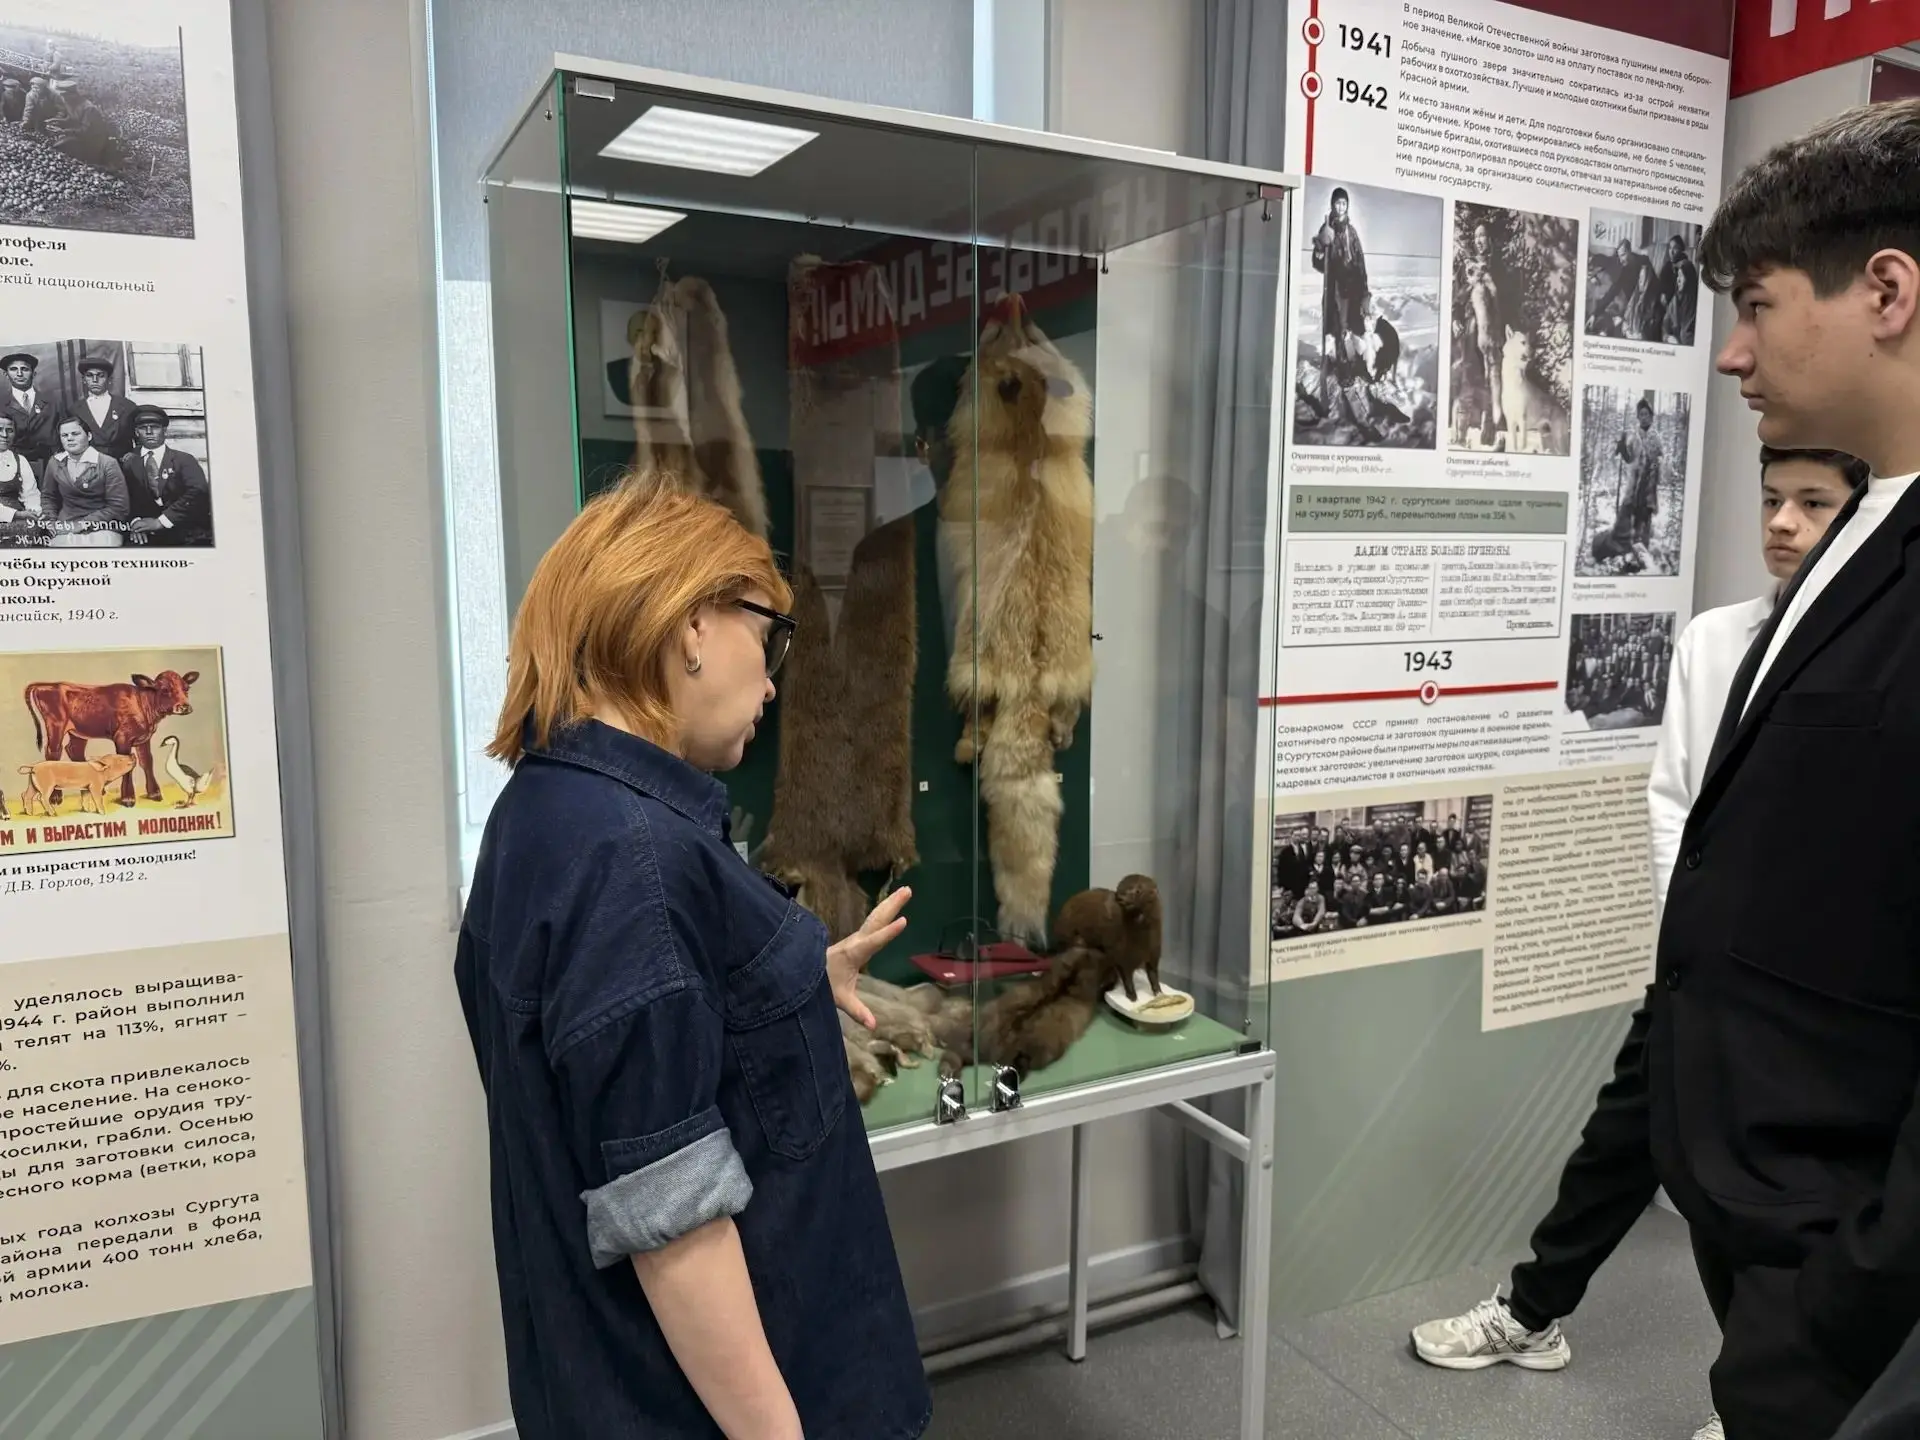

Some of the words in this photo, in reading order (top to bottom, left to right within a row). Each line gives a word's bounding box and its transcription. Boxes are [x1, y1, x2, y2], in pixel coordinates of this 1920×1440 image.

[1338, 24, 1391, 58] 1941
[1402, 19, 1418, 30] ное
[1420, 24, 1464, 42] значение.
[1465, 35, 1500, 50] «Мягкое
[1502, 44, 1534, 58] золото»
[1536, 52, 1554, 63] шло
[1555, 56, 1565, 65] на
[1567, 59, 1595, 74] оплату
[1596, 66, 1632, 80] поставок
[1634, 74, 1644, 83] по
[1645, 77, 1685, 94] ленд-лизу.
[1403, 2, 1409, 12] В
[1412, 6, 1444, 23] период
[1447, 14, 1484, 32] Великой
[1486, 24, 1549, 48] Отечественной
[1552, 42, 1578, 54] войны
[1580, 48, 1619, 63] заготовка
[1621, 58, 1657, 72] пушнины
[1659, 67, 1682, 78] имела
[1683, 71, 1712, 85] оборон-
[1399, 69, 1437, 86] Красной
[1439, 79, 1470, 93] армии.
[1400, 39, 1435, 55] Добыча
[1440, 50, 1477, 65] пушного
[1482, 60, 1507, 73] зверя
[1512, 67, 1564, 85] значительно
[1568, 80, 1619, 97] сократилась
[1623, 91, 1643, 102] из-за
[1647, 96, 1674, 108] острой
[1336, 78, 1388, 110] 1942
[1399, 90, 1410, 101] Их
[1412, 95, 1438, 107] место
[1440, 101, 1470, 114] заняли
[1472, 107, 1496, 119] жёны
[1505, 115, 1527, 125] дети.
[1528, 117, 1544, 129] Для
[1546, 123, 1592, 138] подготовки
[1594, 130, 1615, 143] было
[1616, 136, 1669, 153] организовано
[1395, 167, 1436, 180] пушнины
[1438, 174, 1493, 192] государству.
[37, 276, 154, 292] национальный
[1308, 510, 1340, 520] сумму
[1342, 508, 1364, 518] 5073
[1366, 508, 1388, 520] руб.,
[1316, 495, 1361, 505] квартале
[1366, 495, 1386, 504] 1942
[0, 557, 45, 569] чёбы
[50, 560, 108, 572] курсов
[111, 559, 194, 568] техников-
[1354, 545, 1388, 557] ДАДИМ
[1391, 545, 1428, 556] СТРАНЕ
[23, 574, 110, 589] Окружной
[68, 608, 104, 620] 1940
[109, 611, 118, 619] г.
[1404, 650, 1453, 673] 1943
[1277, 723, 1343, 734] Совнаркомом
[1352, 719, 1377, 729] СССР
[1385, 717, 1418, 728] принял
[1426, 713, 1491, 724] постановление
[1276, 778, 1321, 789] кадровых
[1323, 772, 1387, 784] специалистов
[1396, 767, 1445, 778] охотничьих
[1447, 763, 1495, 773] хозяйствах.
[26, 828, 37, 844] И
[43, 820, 127, 843] ВЫРАСТИМ
[138, 811, 223, 836] МОЛОДНЯК!
[12, 866, 21, 874] и
[26, 859, 109, 874] вырастим
[115, 849, 195, 866] молодняк!
[4, 879, 34, 895] Д.В.
[40, 877, 94, 891] Горлов,
[99, 870, 133, 884] 1942
[138, 872, 147, 880] г.
[14, 987, 122, 1011] уделялось
[135, 973, 242, 993] выращива-
[53, 1014, 65, 1024] г.
[75, 1004, 136, 1024] район
[146, 991, 244, 1012] выполнил
[14, 1033, 70, 1048] телят
[83, 1029, 105, 1040] на
[118, 1019, 164, 1036] 113%,
[174, 1012, 226, 1028] ягнят
[6, 1085, 43, 1100] для
[49, 1076, 104, 1092] скота
[110, 1056, 249, 1085] привлекалось
[22, 1092, 137, 1116] население.
[144, 1086, 168, 1098] На
[176, 1075, 250, 1093] сеноко-
[134, 1100, 203, 1120] орудия
[214, 1093, 252, 1108] тру-
[96, 1125, 171, 1146] грабли.
[179, 1112, 253, 1131] Осенью
[27, 1160, 63, 1176] для
[75, 1143, 173, 1167] заготовки
[184, 1131, 255, 1149] силоса,
[71, 1169, 132, 1187] корма
[140, 1158, 206, 1178] (ветки,
[212, 1149, 255, 1164] кора
[38, 1223, 82, 1238] года
[94, 1207, 174, 1229] колхозы
[185, 1193, 258, 1214] Сургута
[77, 1226, 172, 1250] передали
[188, 1222, 197, 1231] в
[212, 1211, 260, 1229] фонд
[26, 1259, 90, 1279] армии
[102, 1249, 138, 1264] 400
[149, 1241, 192, 1256] тонн
[204, 1228, 262, 1247] хлеба,
[10, 1280, 89, 1301] молока.
